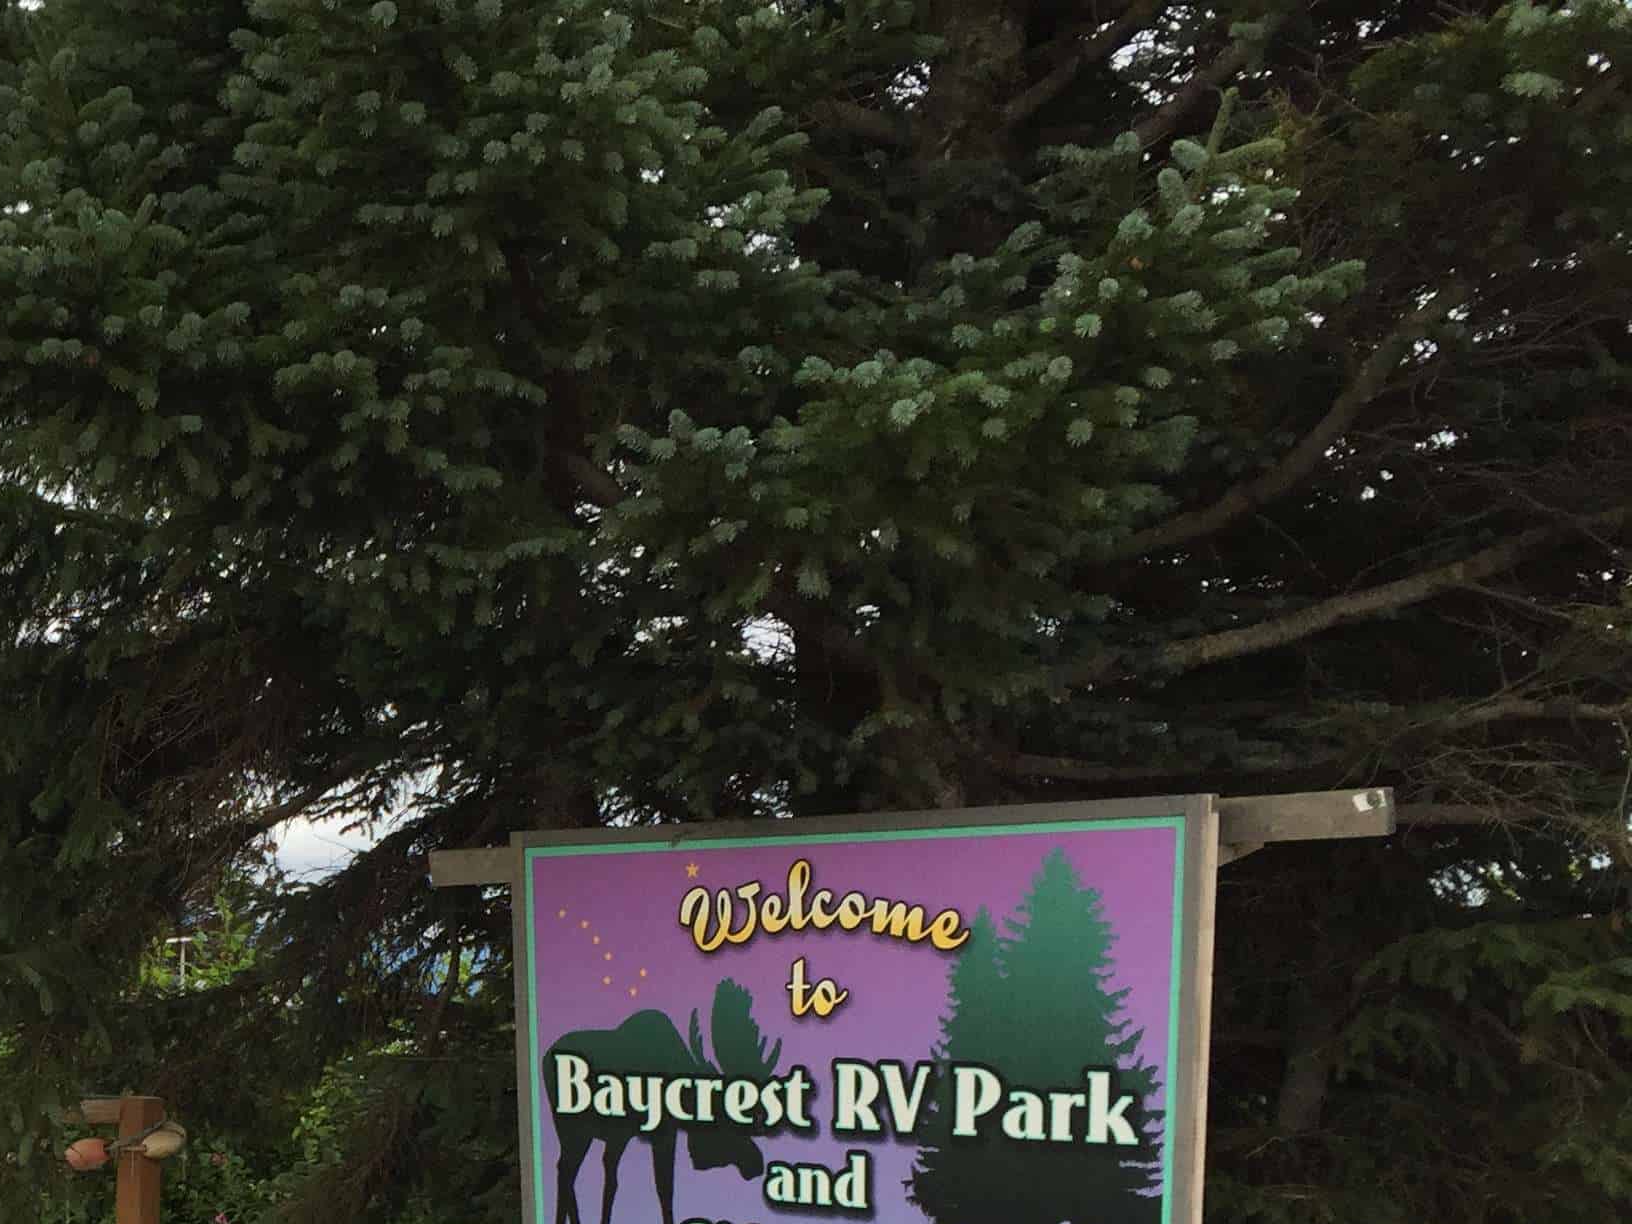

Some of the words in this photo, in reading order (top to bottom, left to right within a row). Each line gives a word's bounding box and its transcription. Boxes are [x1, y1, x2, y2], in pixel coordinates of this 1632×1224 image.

[679, 858, 971, 952] Welcome
[786, 956, 848, 1018] to
[554, 1053, 811, 1131] Baycrest
[834, 1062, 931, 1133] RV
[952, 1066, 1139, 1145] Park
[766, 1154, 868, 1209] and
